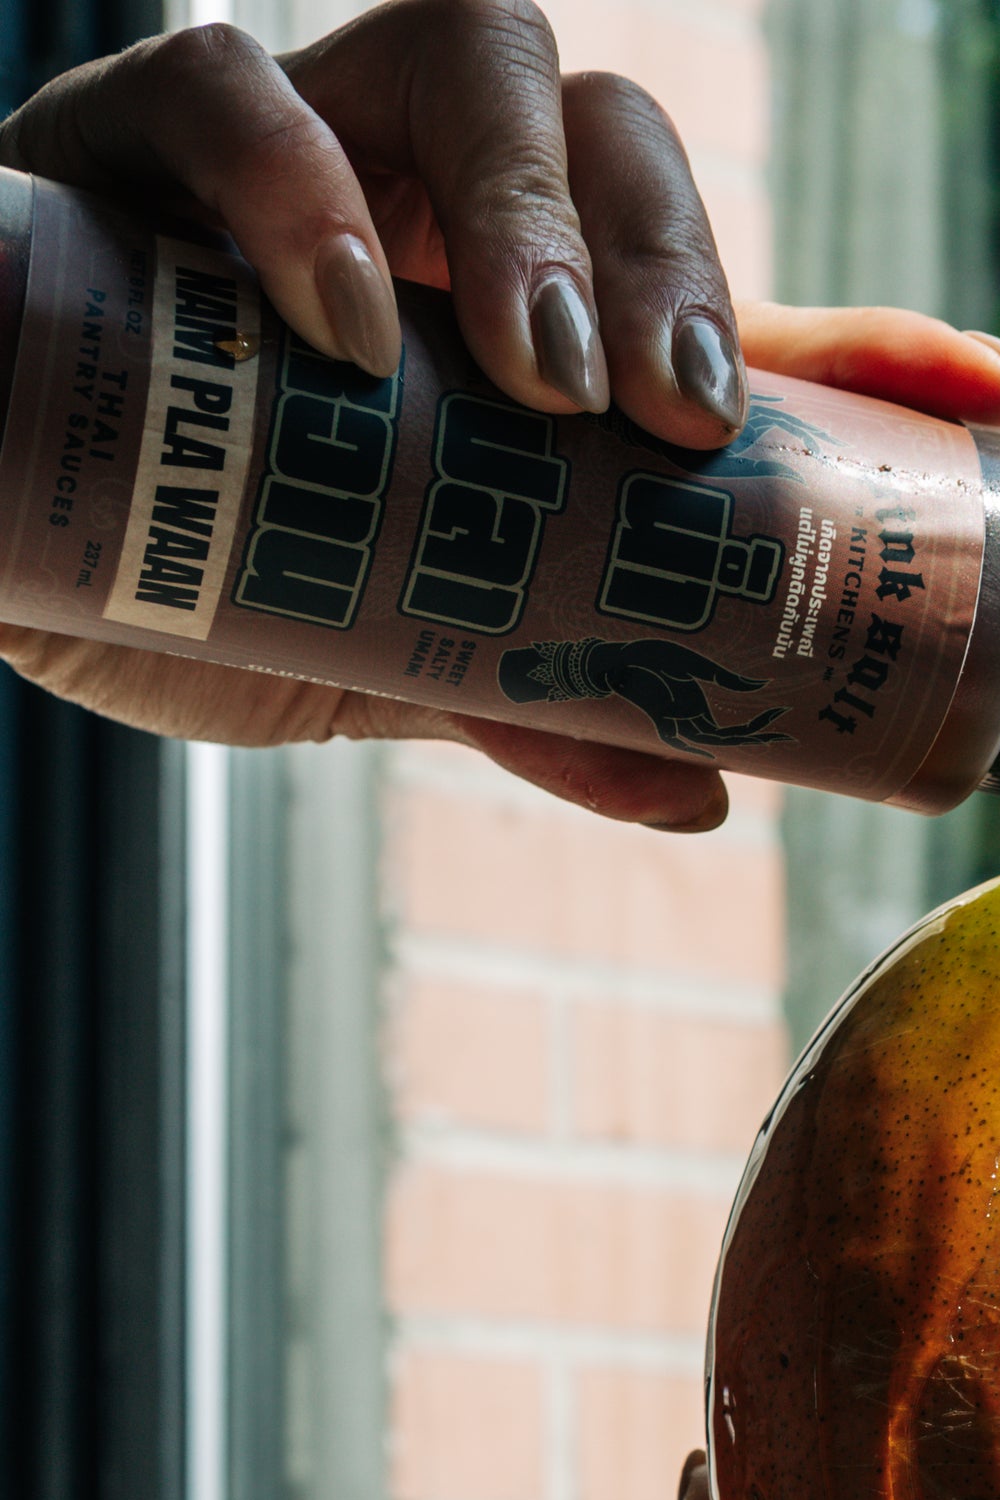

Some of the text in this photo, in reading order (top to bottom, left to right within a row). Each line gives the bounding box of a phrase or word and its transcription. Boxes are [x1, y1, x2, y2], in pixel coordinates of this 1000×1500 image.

[124, 310, 143, 335] OZ
[128, 287, 145, 306] FL
[172, 265, 238, 371] NAM
[49, 287, 107, 528] PANTRY SAUCES
[89, 370, 129, 462] THAI
[160, 373, 233, 471] PLA
[134, 484, 220, 612] WAAN
[398, 388, 571, 637] ปลา
[75, 539, 103, 588] 237 mL
[796, 518, 837, 658] เกิดจากประเพณี
[828, 526, 868, 660] KITCHENS
[403, 629, 436, 678] UMAMI
[425, 637, 456, 680] SALTY
[445, 640, 477, 687] SWEET
